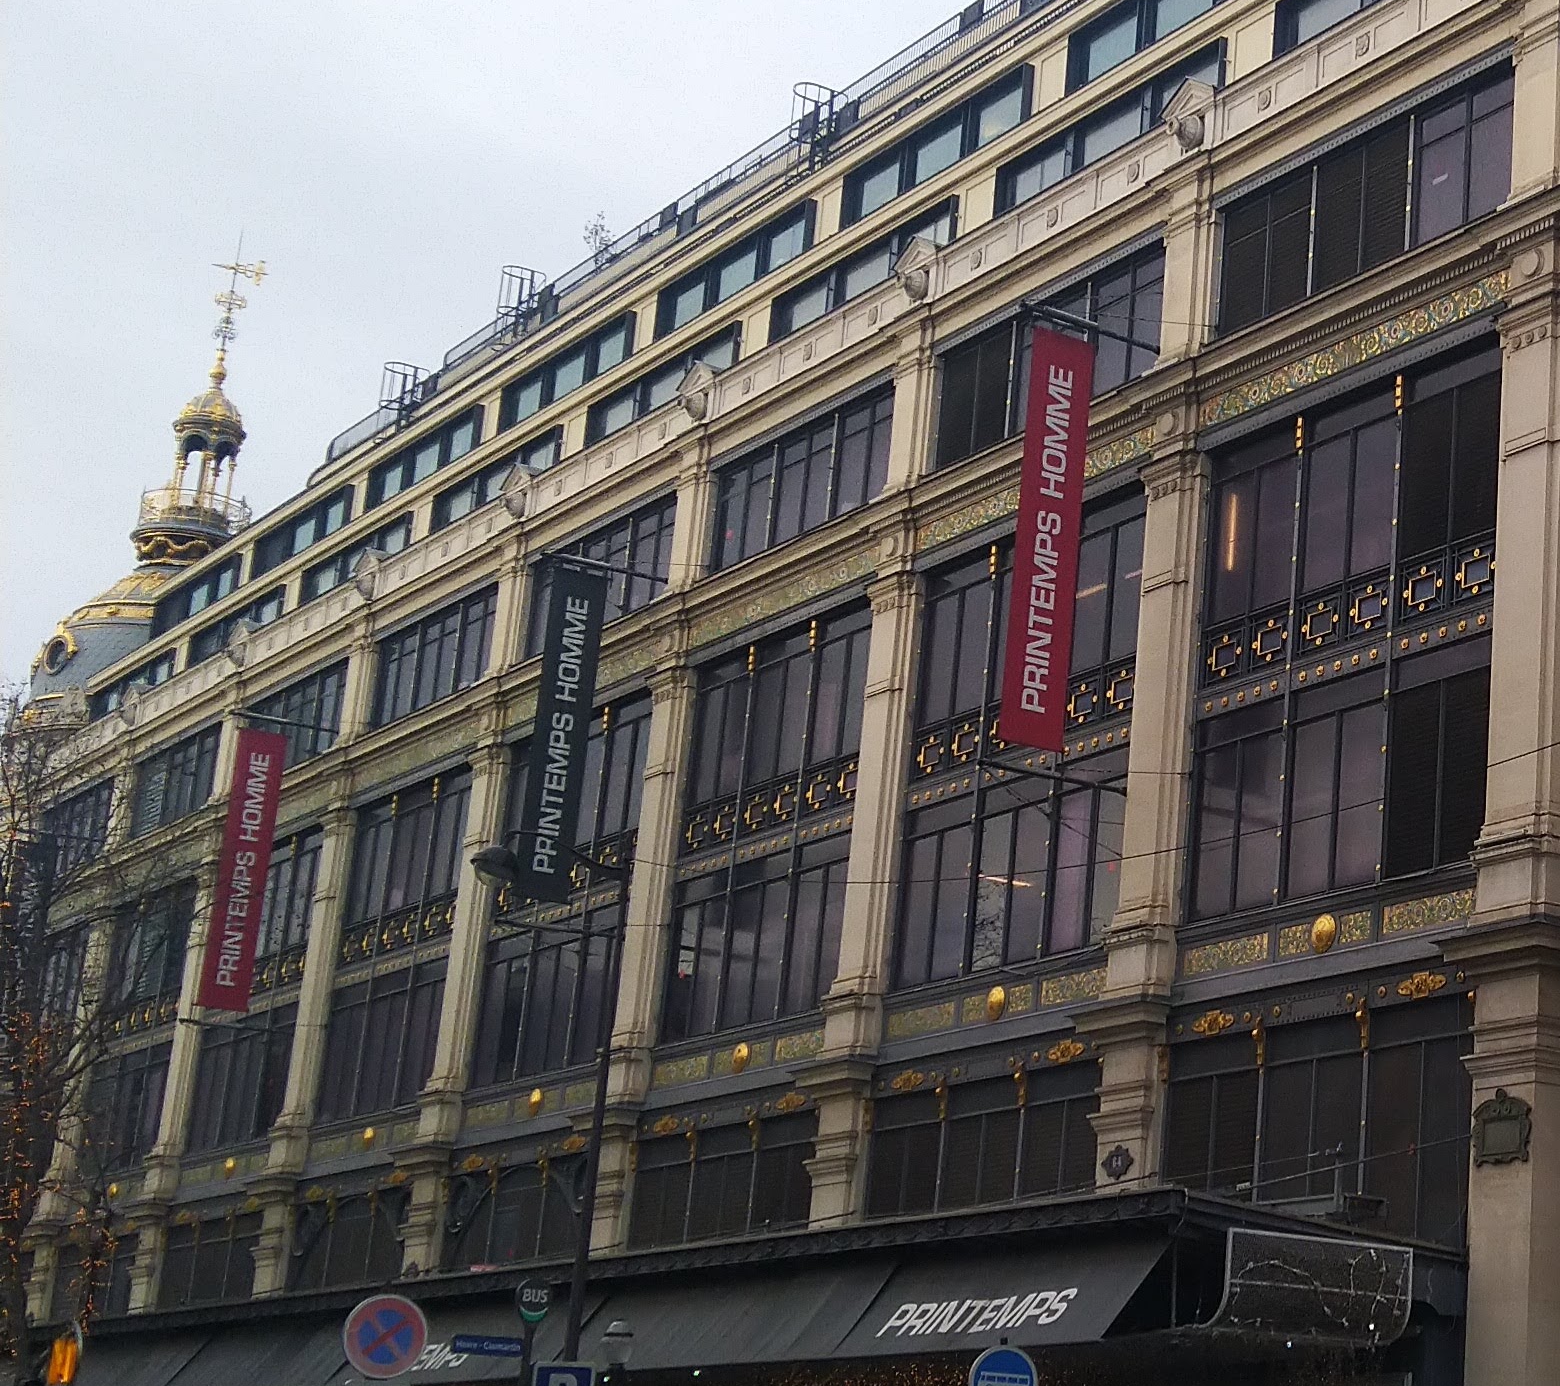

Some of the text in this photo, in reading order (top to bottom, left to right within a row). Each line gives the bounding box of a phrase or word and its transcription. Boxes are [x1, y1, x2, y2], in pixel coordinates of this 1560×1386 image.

[1020, 364, 1073, 714] PRINTEMPS HOMME
[532, 595, 589, 875] PRINTEMPS HOMME
[216, 752, 271, 988] PRINTEMPS HOMME
[522, 1289, 548, 1303] BUS
[875, 1287, 1078, 1338] PRINTEMPS
